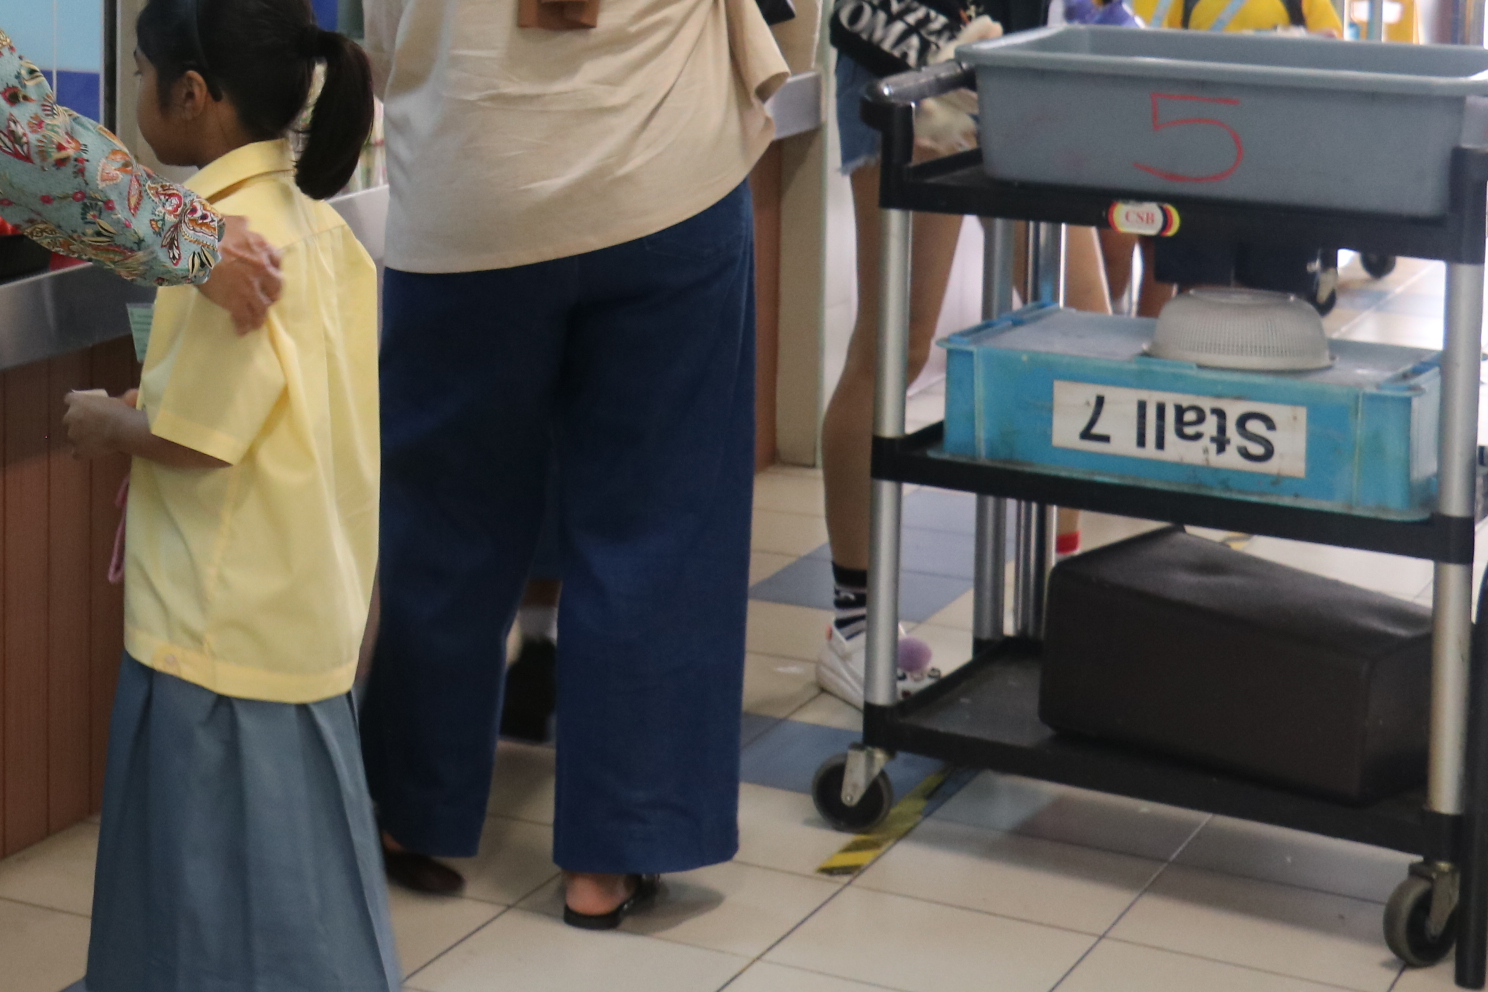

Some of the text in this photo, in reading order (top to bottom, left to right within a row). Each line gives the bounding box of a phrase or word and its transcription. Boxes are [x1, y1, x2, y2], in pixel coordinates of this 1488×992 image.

[1132, 92, 1245, 183] 5
[1124, 211, 1156, 225] CSB
[1078, 394, 1278, 463] Stall 7
